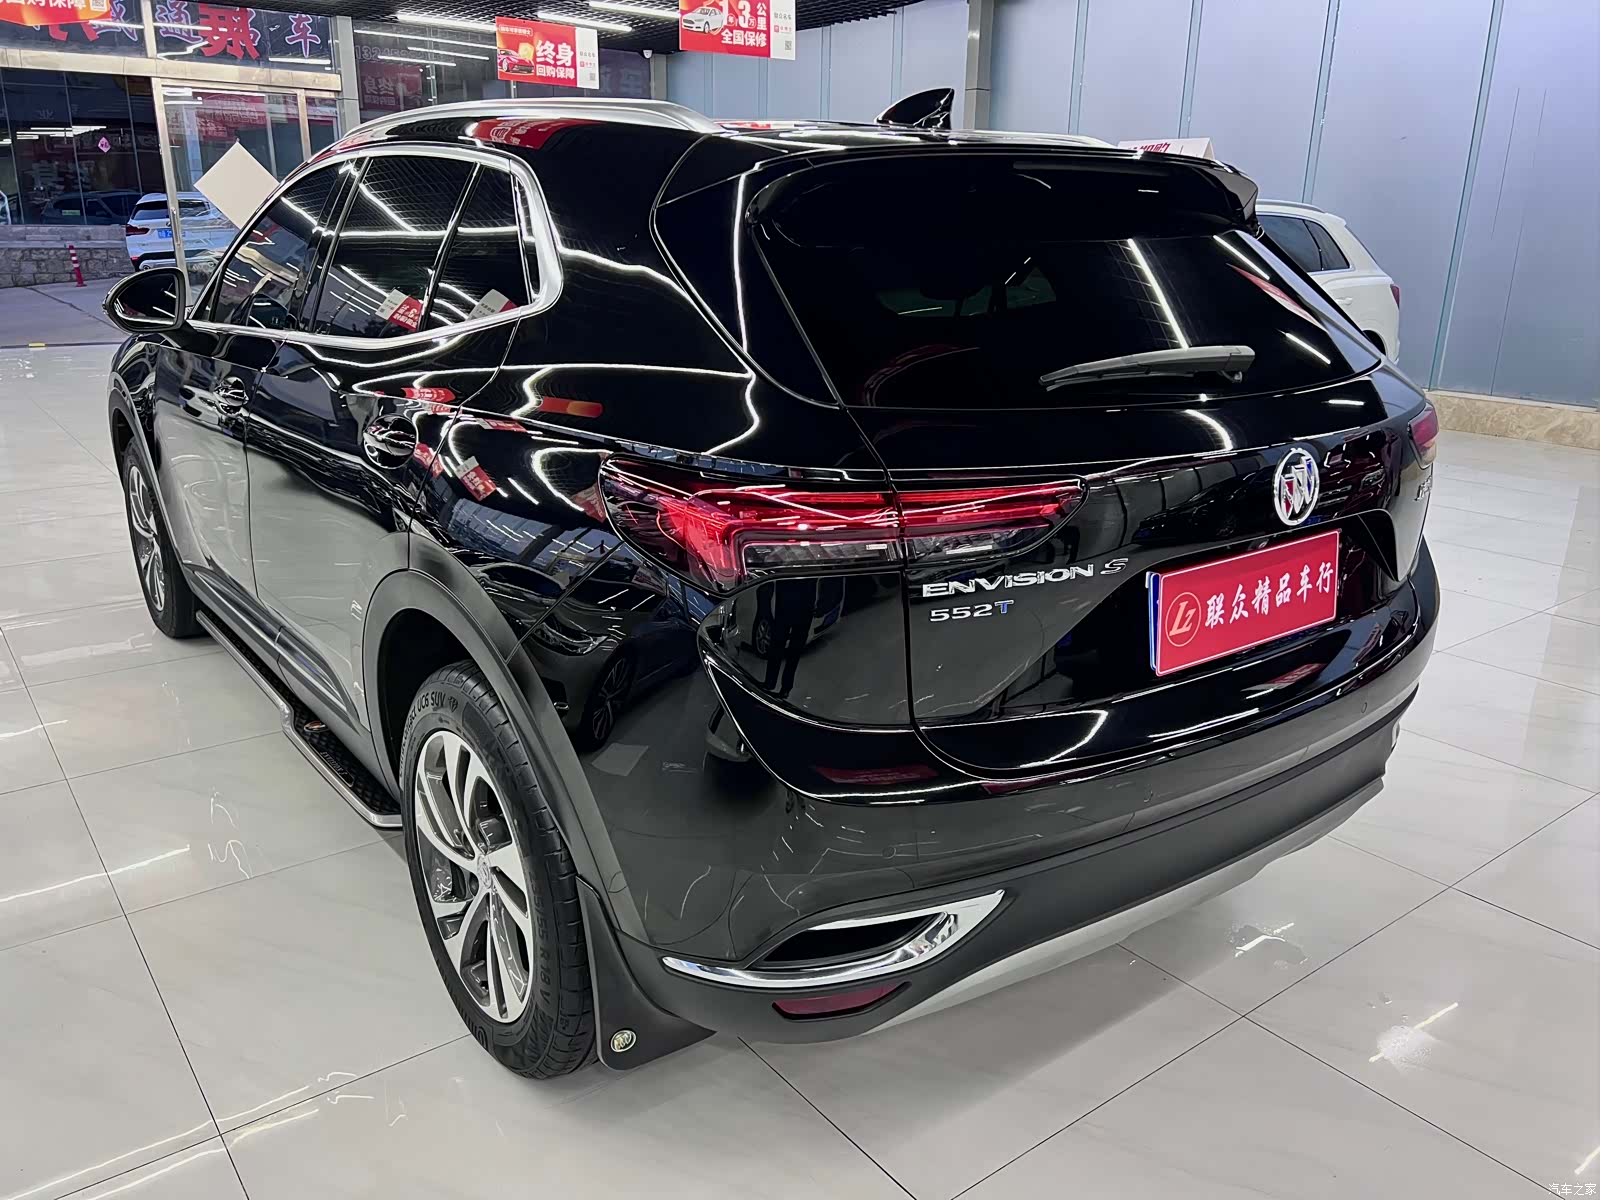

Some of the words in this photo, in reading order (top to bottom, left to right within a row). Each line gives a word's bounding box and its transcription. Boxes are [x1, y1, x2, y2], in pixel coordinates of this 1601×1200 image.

[721, 28, 768, 48] 全国保修
[535, 39, 574, 67] 终身
[535, 63, 576, 80] 回购保障
[922, 563, 1095, 598] ENVISION
[1100, 557, 1129, 576] S
[1205, 562, 1334, 630] 联众精品车行
[930, 599, 1015, 623] 552T
